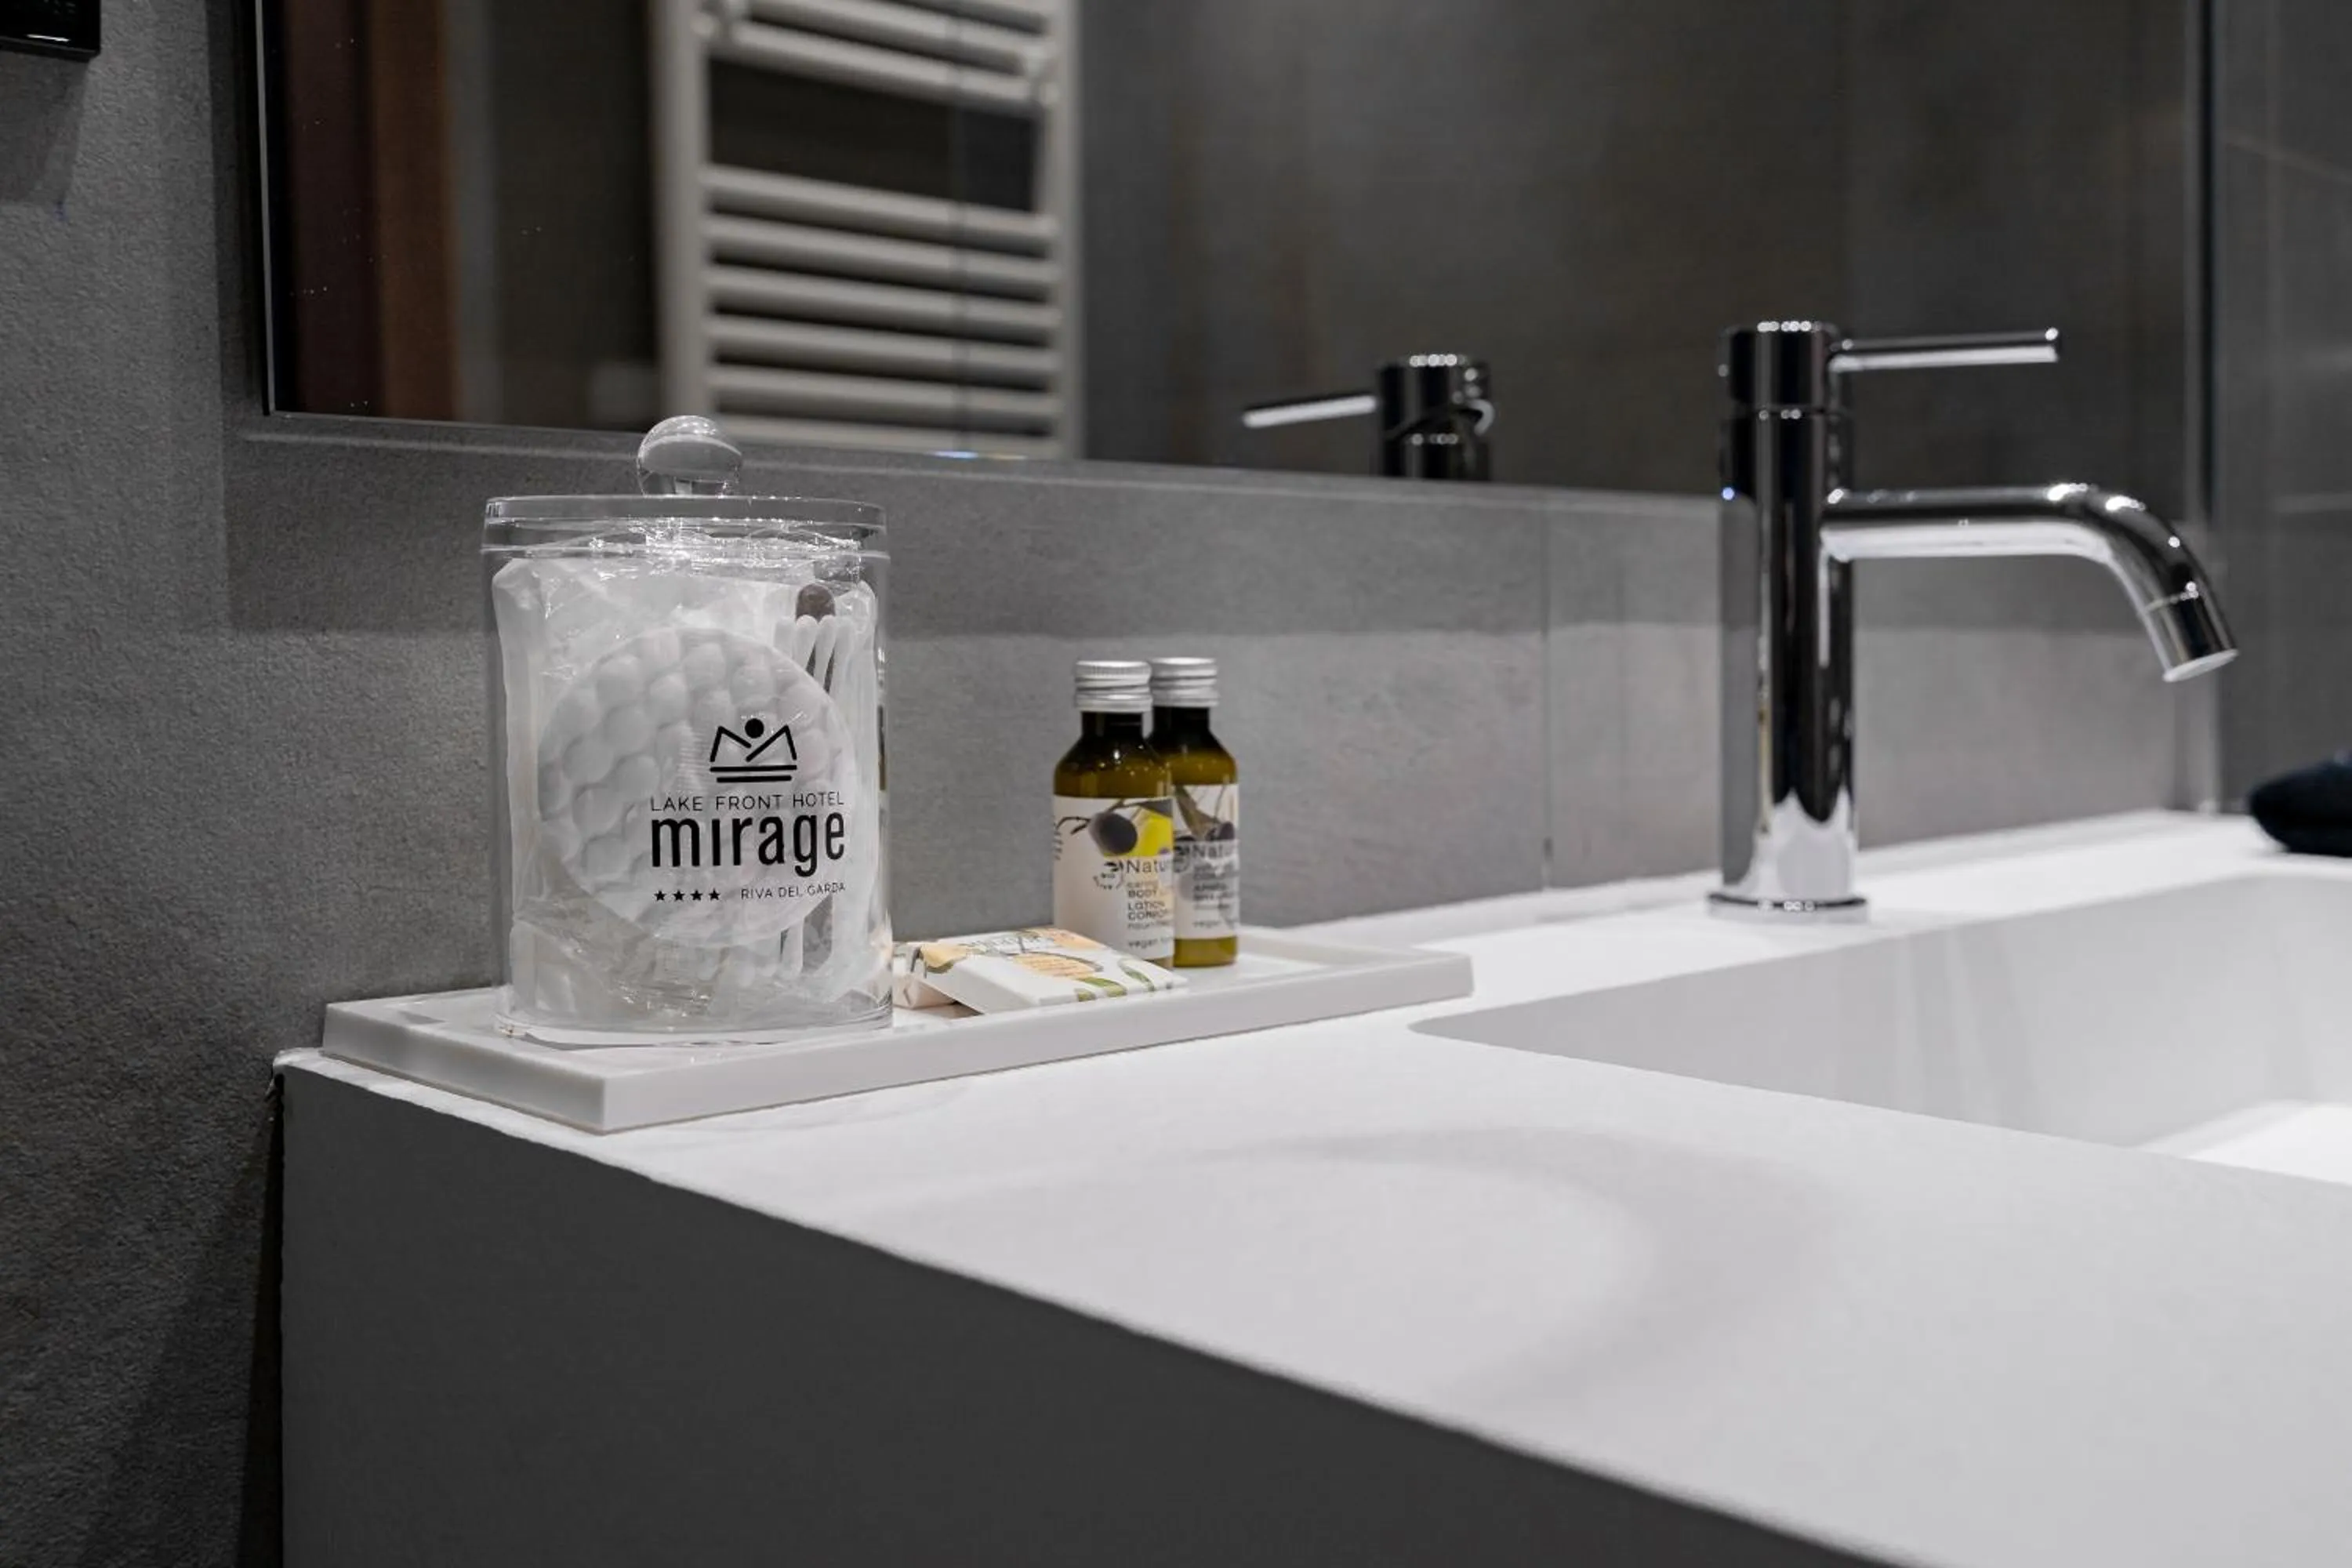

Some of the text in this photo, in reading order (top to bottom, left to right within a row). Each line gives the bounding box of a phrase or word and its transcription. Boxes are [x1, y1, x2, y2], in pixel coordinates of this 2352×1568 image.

[650, 791, 844, 811] LAKE FRONT HOTEL
[651, 812, 845, 877] mirage
[741, 882, 846, 900] RIVA DEL GARDA
